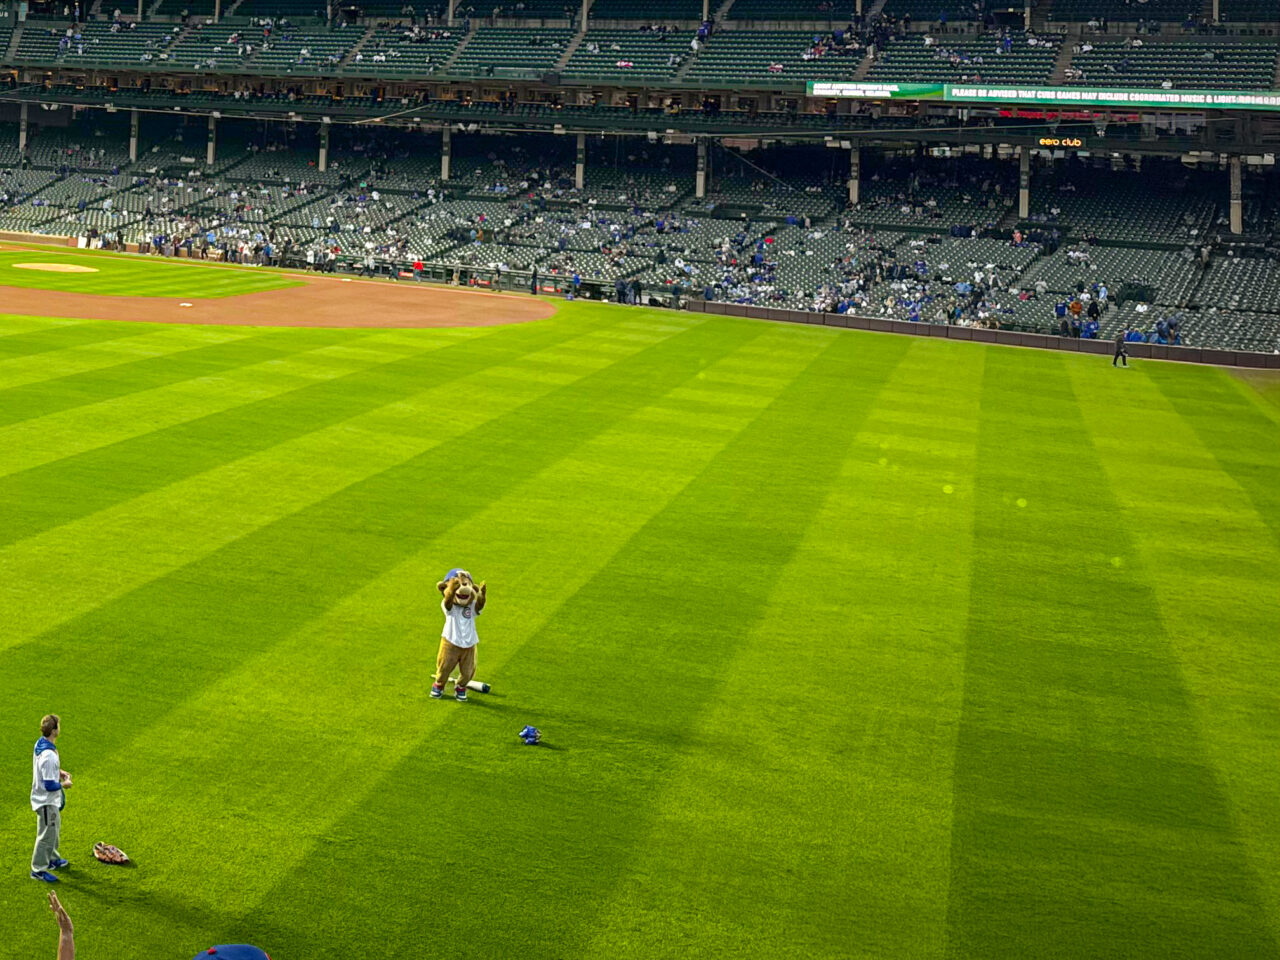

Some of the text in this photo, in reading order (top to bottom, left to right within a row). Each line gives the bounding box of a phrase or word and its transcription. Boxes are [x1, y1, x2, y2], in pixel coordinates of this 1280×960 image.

[1037, 91, 1056, 99] CUBS
[1082, 92, 1097, 100] MAY
[1130, 93, 1180, 102] COORDINATED
[1181, 94, 1204, 102] MUSIC
[1062, 138, 1081, 146] club
